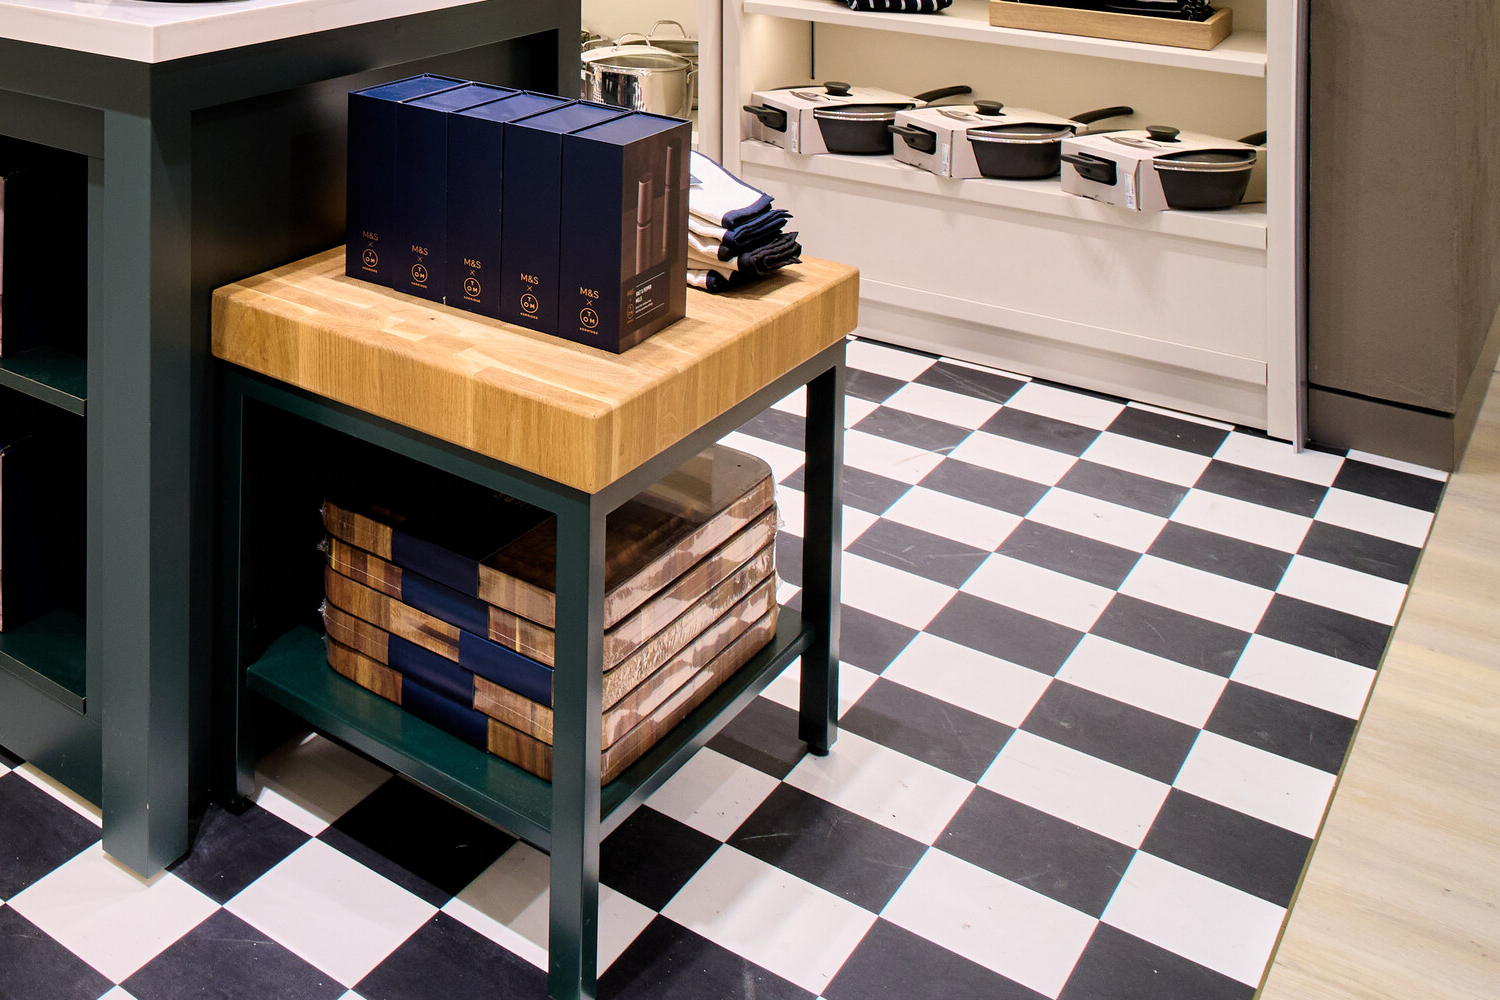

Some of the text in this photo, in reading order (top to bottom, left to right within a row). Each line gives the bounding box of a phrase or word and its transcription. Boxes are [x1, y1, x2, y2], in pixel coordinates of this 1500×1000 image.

[362, 229, 379, 241] M&S
[411, 244, 429, 256] M&S
[463, 257, 482, 270] M&S
[520, 272, 539, 285] M&S
[579, 286, 600, 300] M&S
